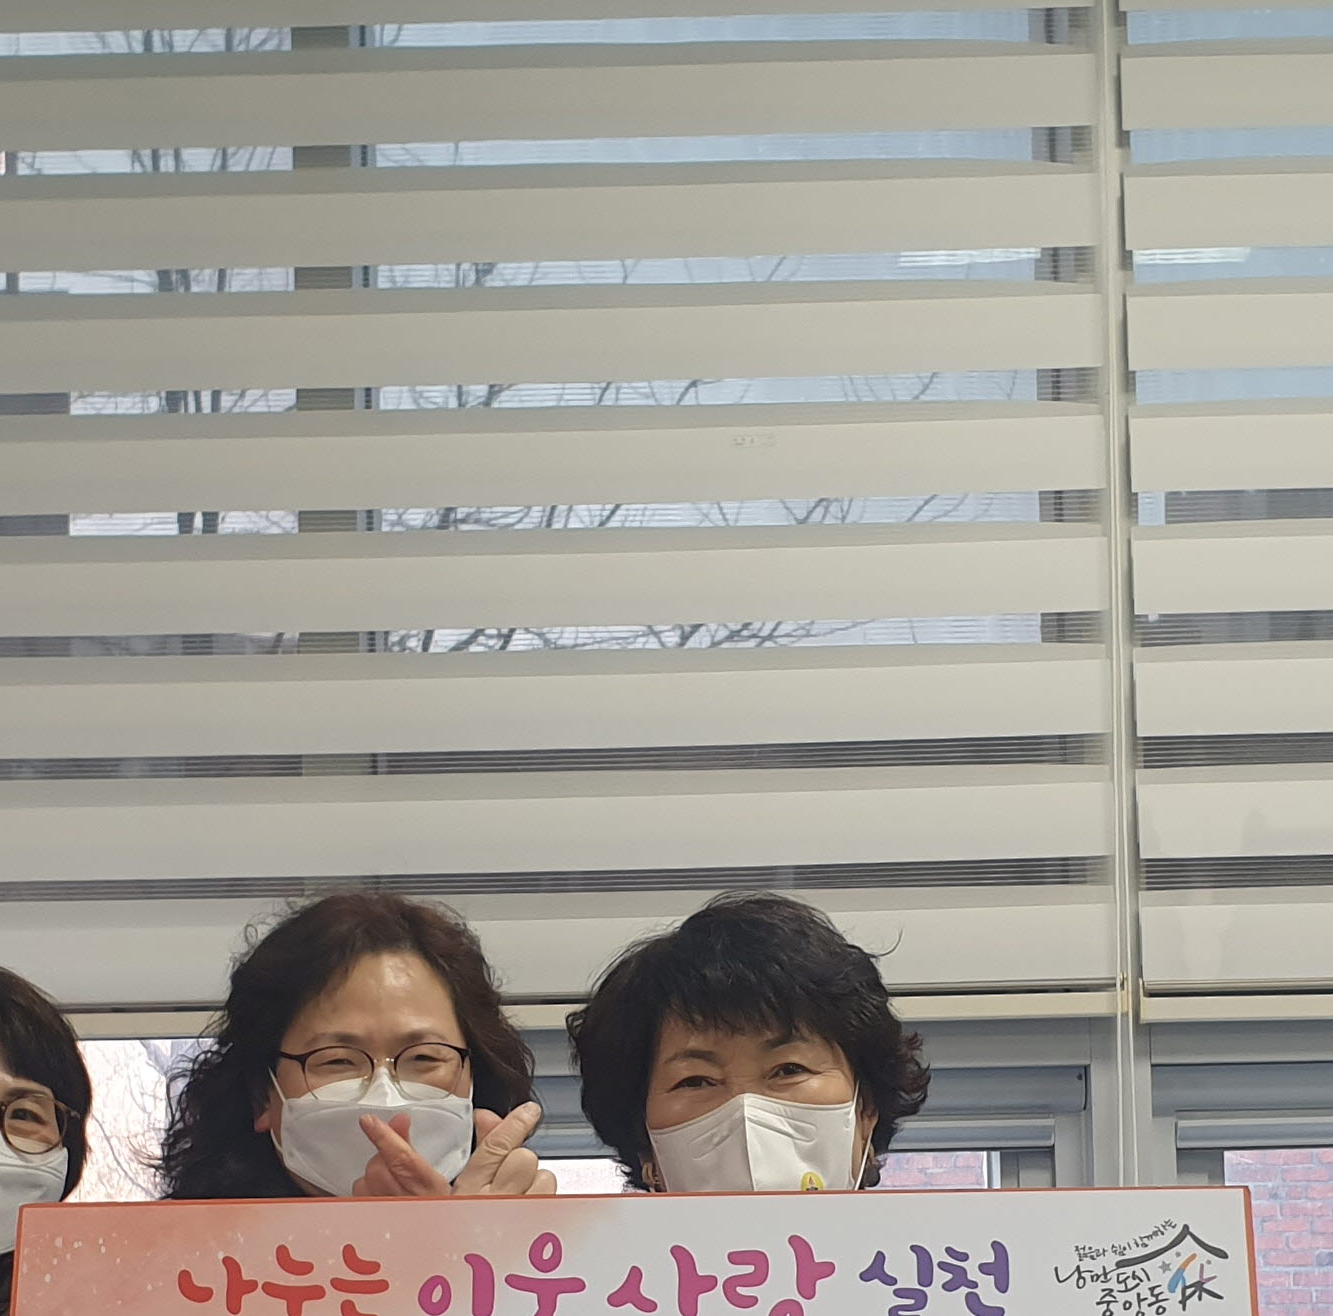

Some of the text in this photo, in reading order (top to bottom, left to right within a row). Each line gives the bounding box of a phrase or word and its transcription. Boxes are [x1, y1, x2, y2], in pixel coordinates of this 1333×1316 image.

[1133, 1218, 1178, 1249] 함께하는
[1054, 1264, 1152, 1293] 낭만 도시
